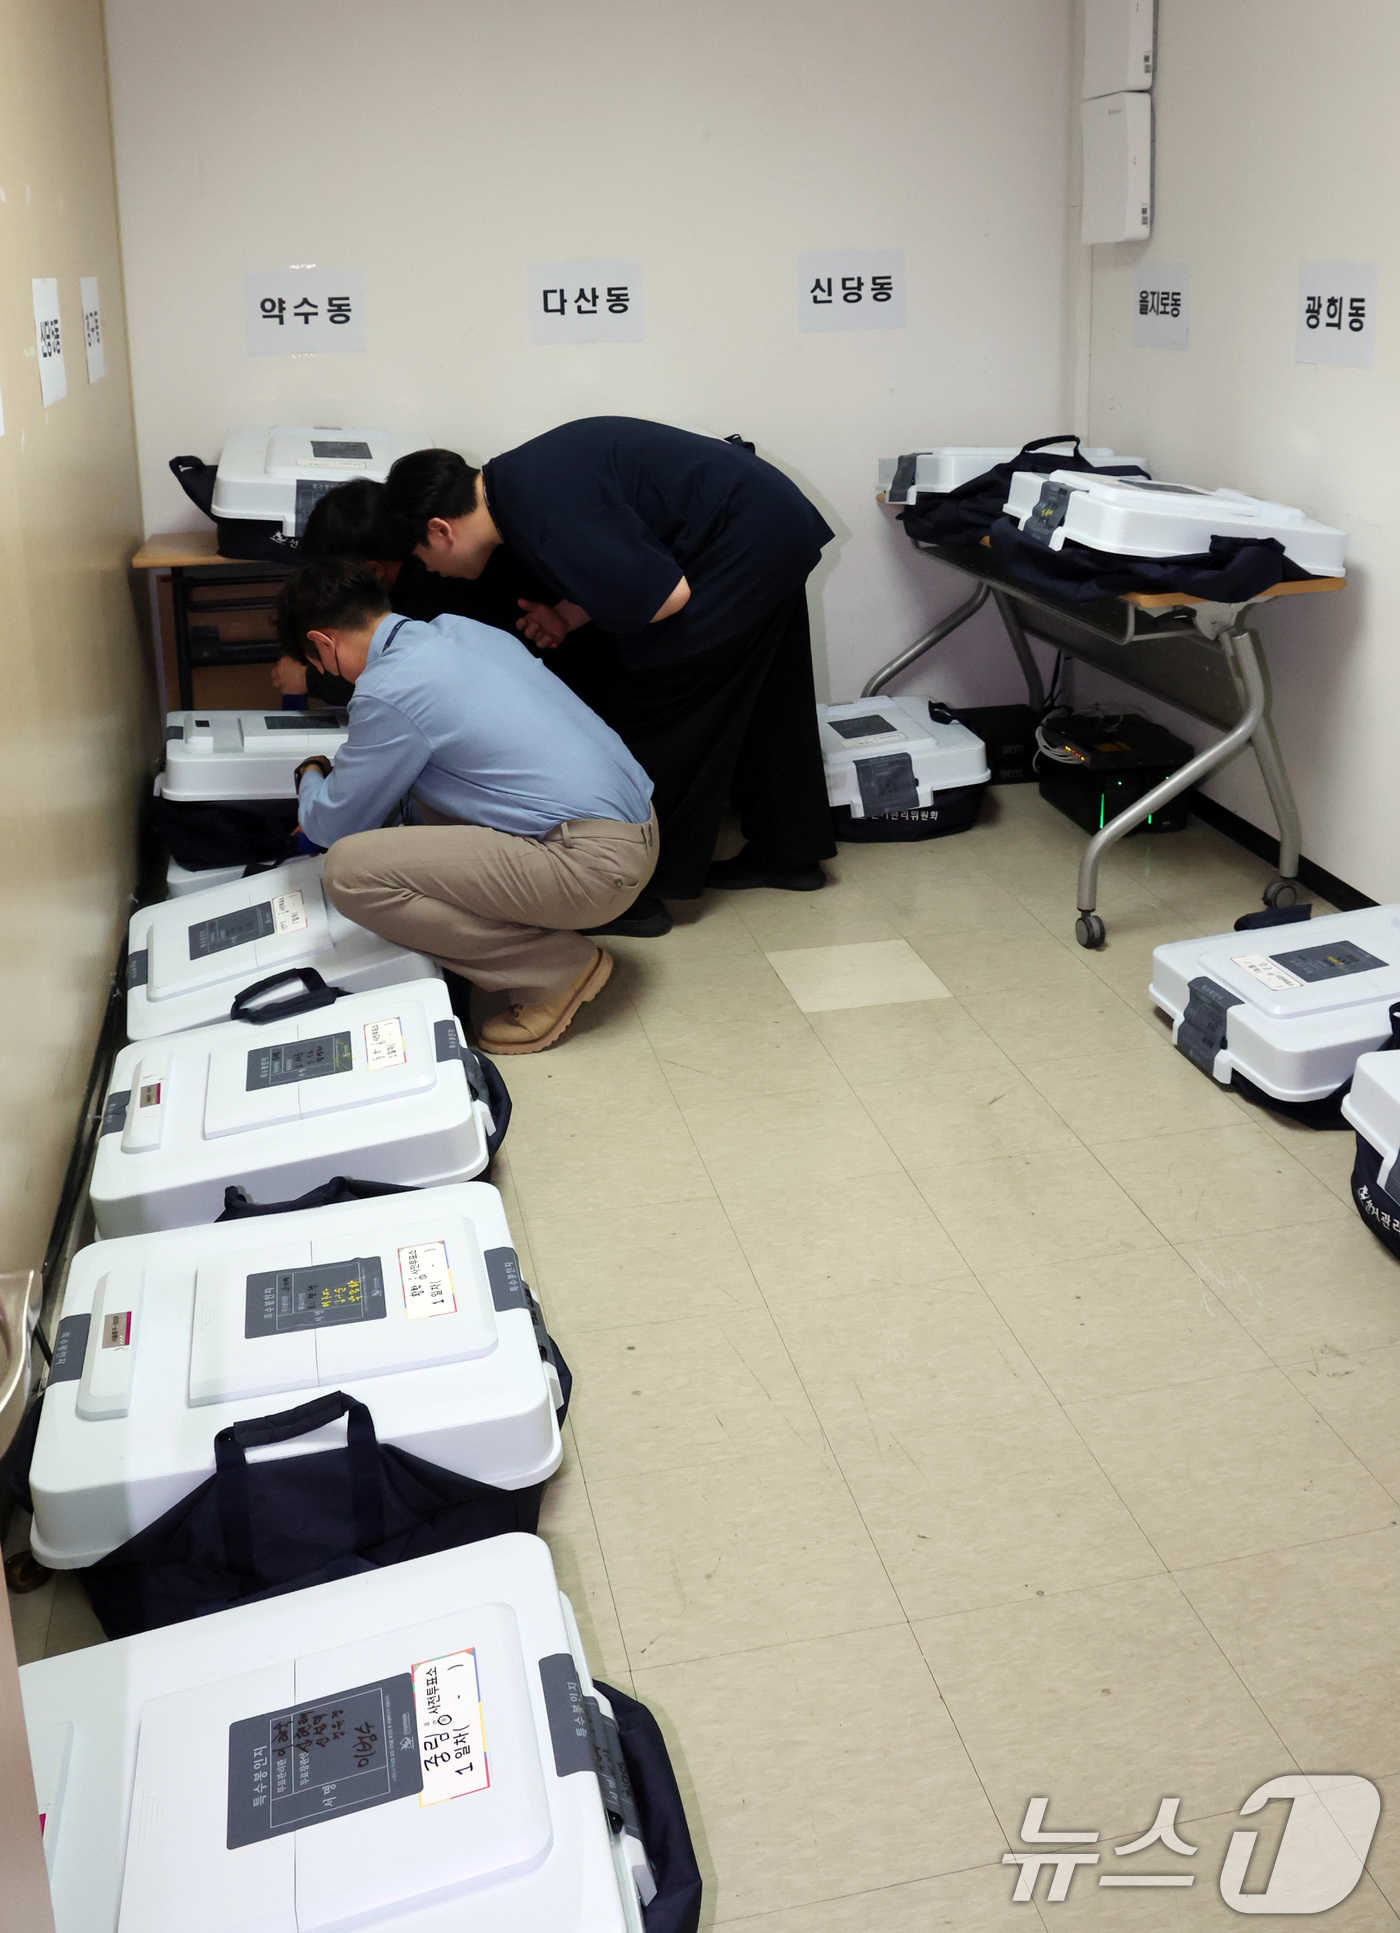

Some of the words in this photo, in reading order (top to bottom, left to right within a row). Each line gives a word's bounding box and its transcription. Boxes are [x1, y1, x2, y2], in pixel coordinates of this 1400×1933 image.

[542, 286, 631, 315] 다산동
[810, 276, 893, 305] 신당동
[1139, 290, 1182, 318] 을지로동
[260, 296, 352, 326] 약수동
[1305, 296, 1366, 332] 광희동
[871, 810, 939, 821] 관리위원회
[407, 1249, 420, 1275] 사전투표소
[424, 1665, 441, 1716] 사전투표소
[422, 1729, 451, 1771] 중림
[252, 1744, 267, 1808] 특수봉인지
[454, 1761, 473, 1776] 1
